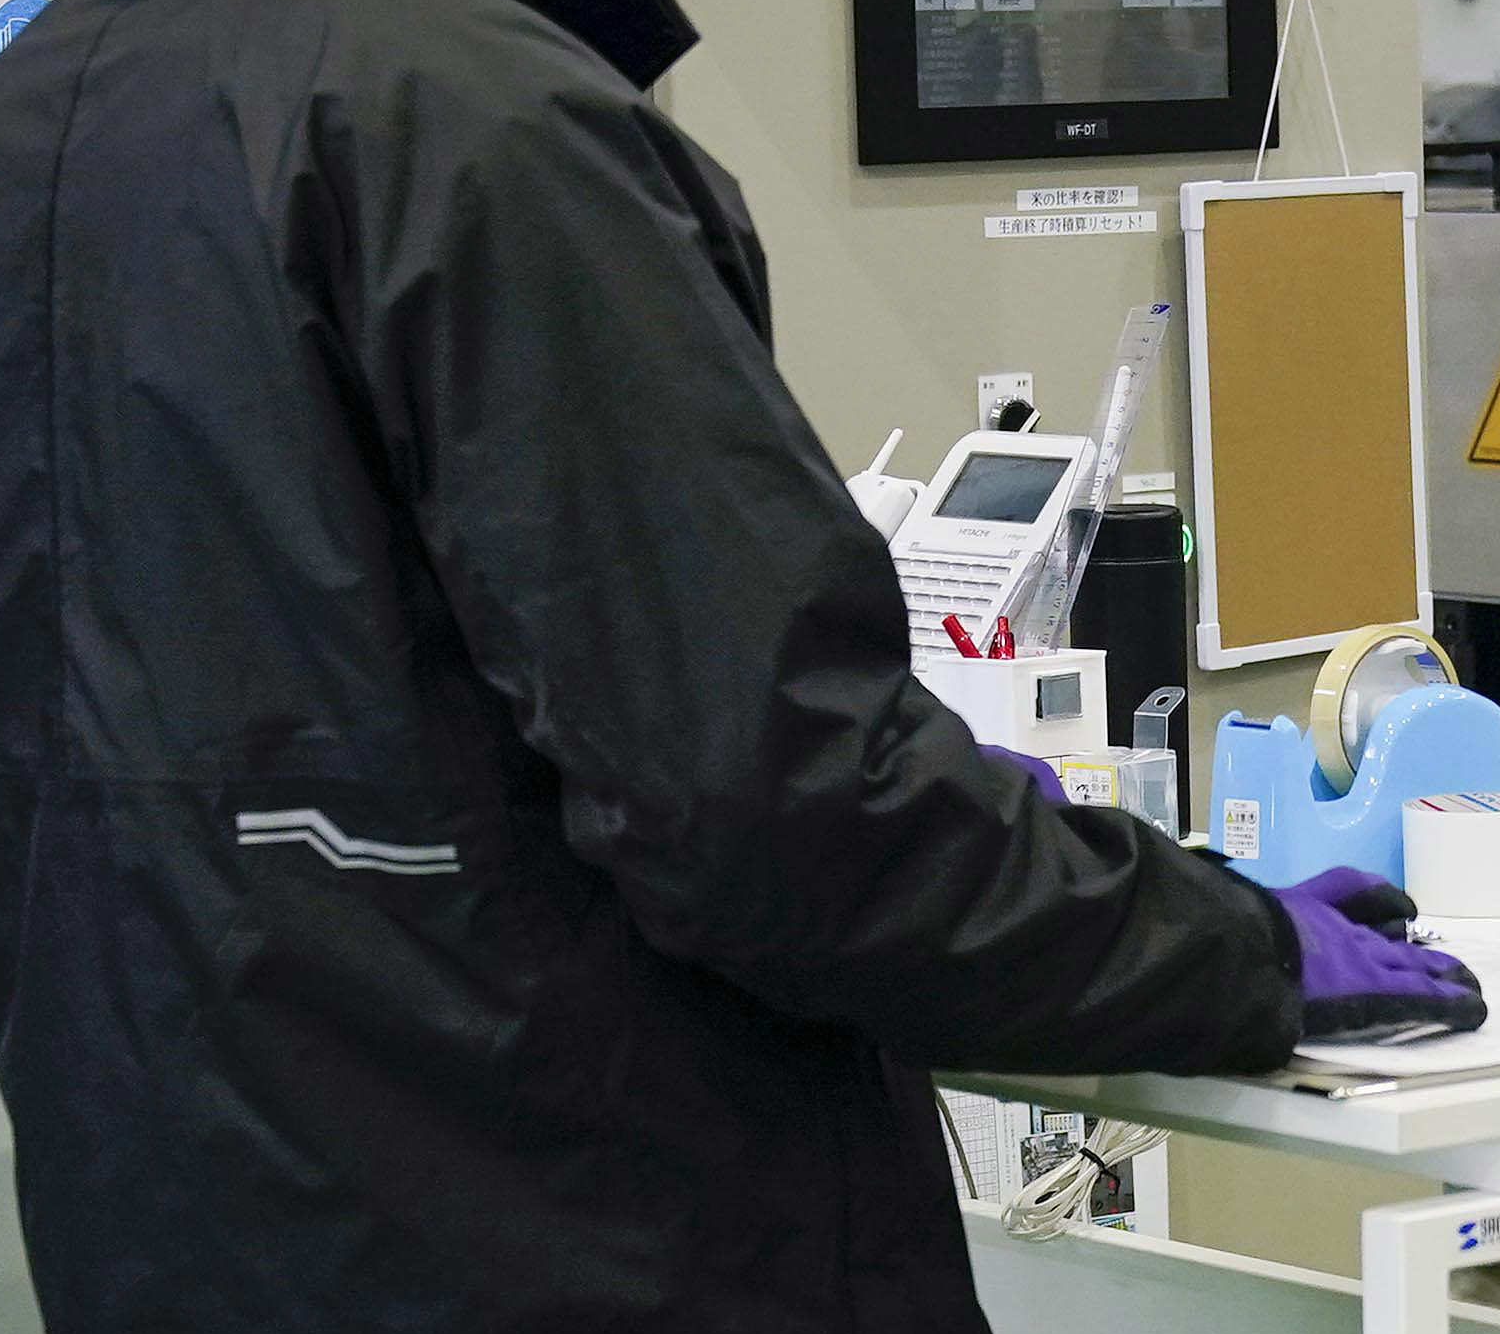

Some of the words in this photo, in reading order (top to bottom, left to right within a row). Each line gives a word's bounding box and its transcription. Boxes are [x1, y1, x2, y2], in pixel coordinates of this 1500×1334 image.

[1066, 123, 1097, 137] WF-DT
[998, 214, 1143, 236] 生産終了時積算リセット!
